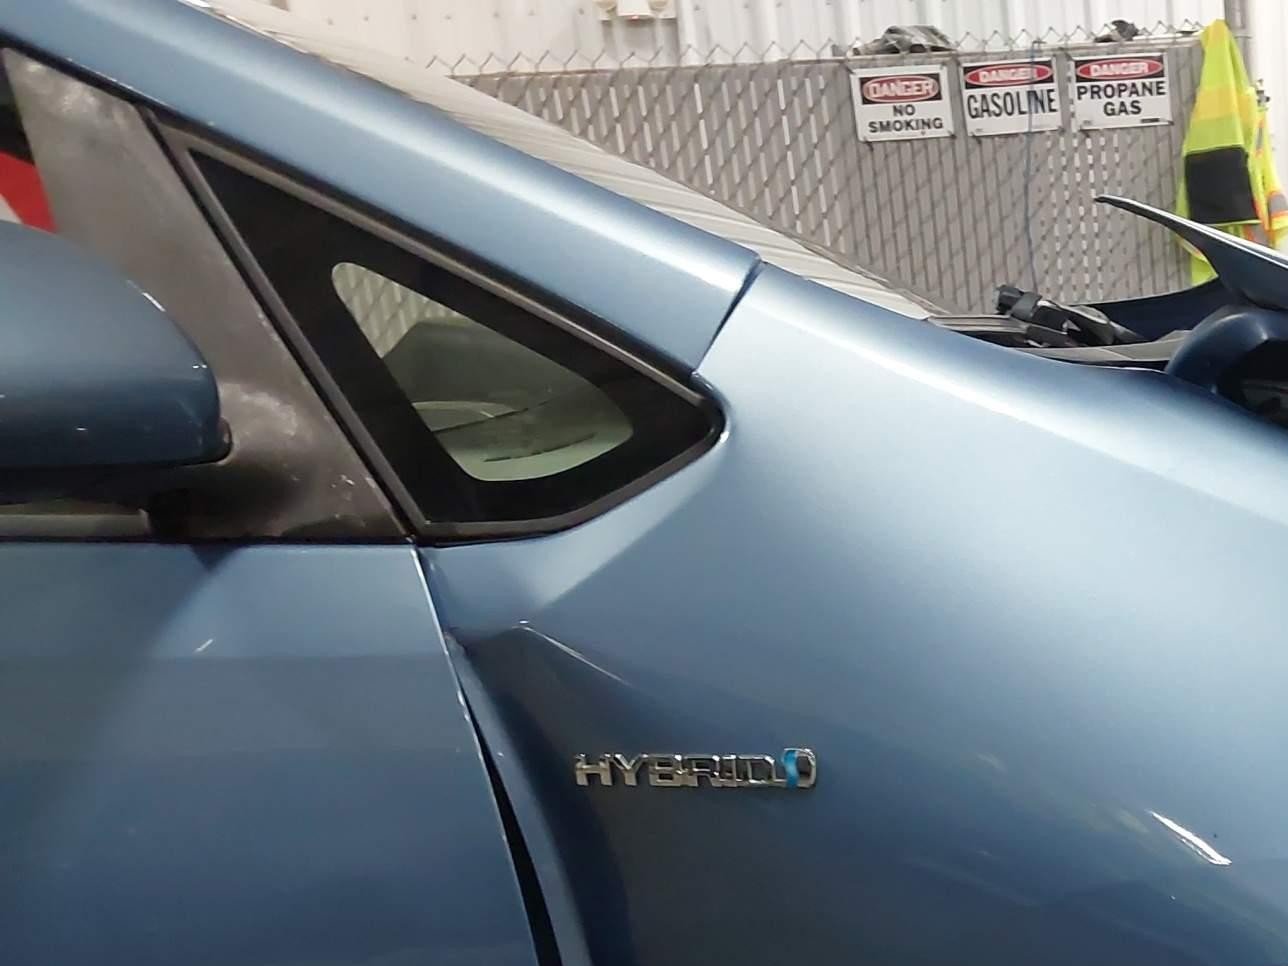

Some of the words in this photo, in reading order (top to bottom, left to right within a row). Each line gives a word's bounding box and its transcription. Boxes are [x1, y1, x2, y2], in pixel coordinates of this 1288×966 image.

[979, 67, 1039, 83] DANGER
[1089, 62, 1149, 77] DANGER
[868, 79, 934, 98] DANGER
[1077, 80, 1166, 100] PROPANE
[893, 104, 916, 117] NO
[967, 88, 1058, 119] GASOLINE
[1103, 100, 1142, 117] GAS
[868, 117, 944, 133] SMOKING
[574, 753, 776, 788] HYBRID
